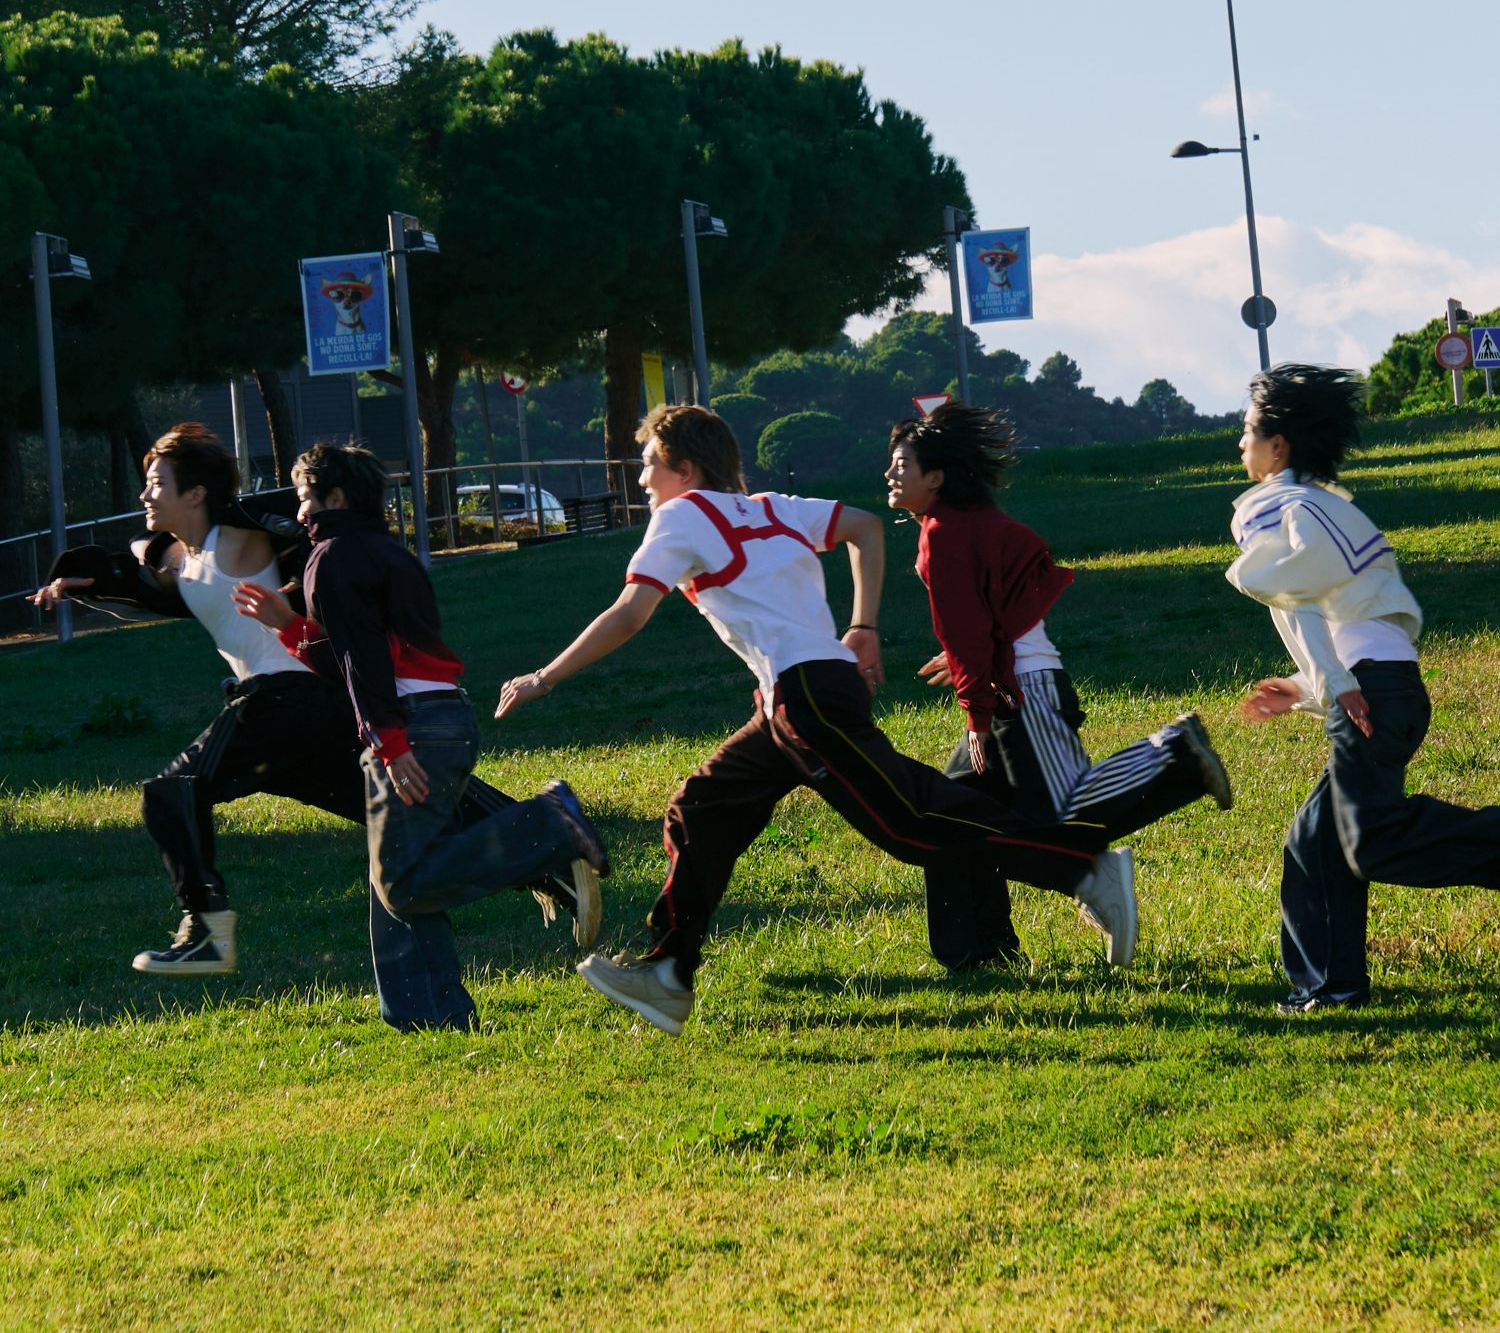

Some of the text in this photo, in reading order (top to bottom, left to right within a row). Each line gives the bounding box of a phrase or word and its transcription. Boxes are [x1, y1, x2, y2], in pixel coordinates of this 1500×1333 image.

[314, 332, 382, 347] LA MERDA DE GOS
[320, 346, 331, 355] NO
[334, 344, 355, 354] DONA
